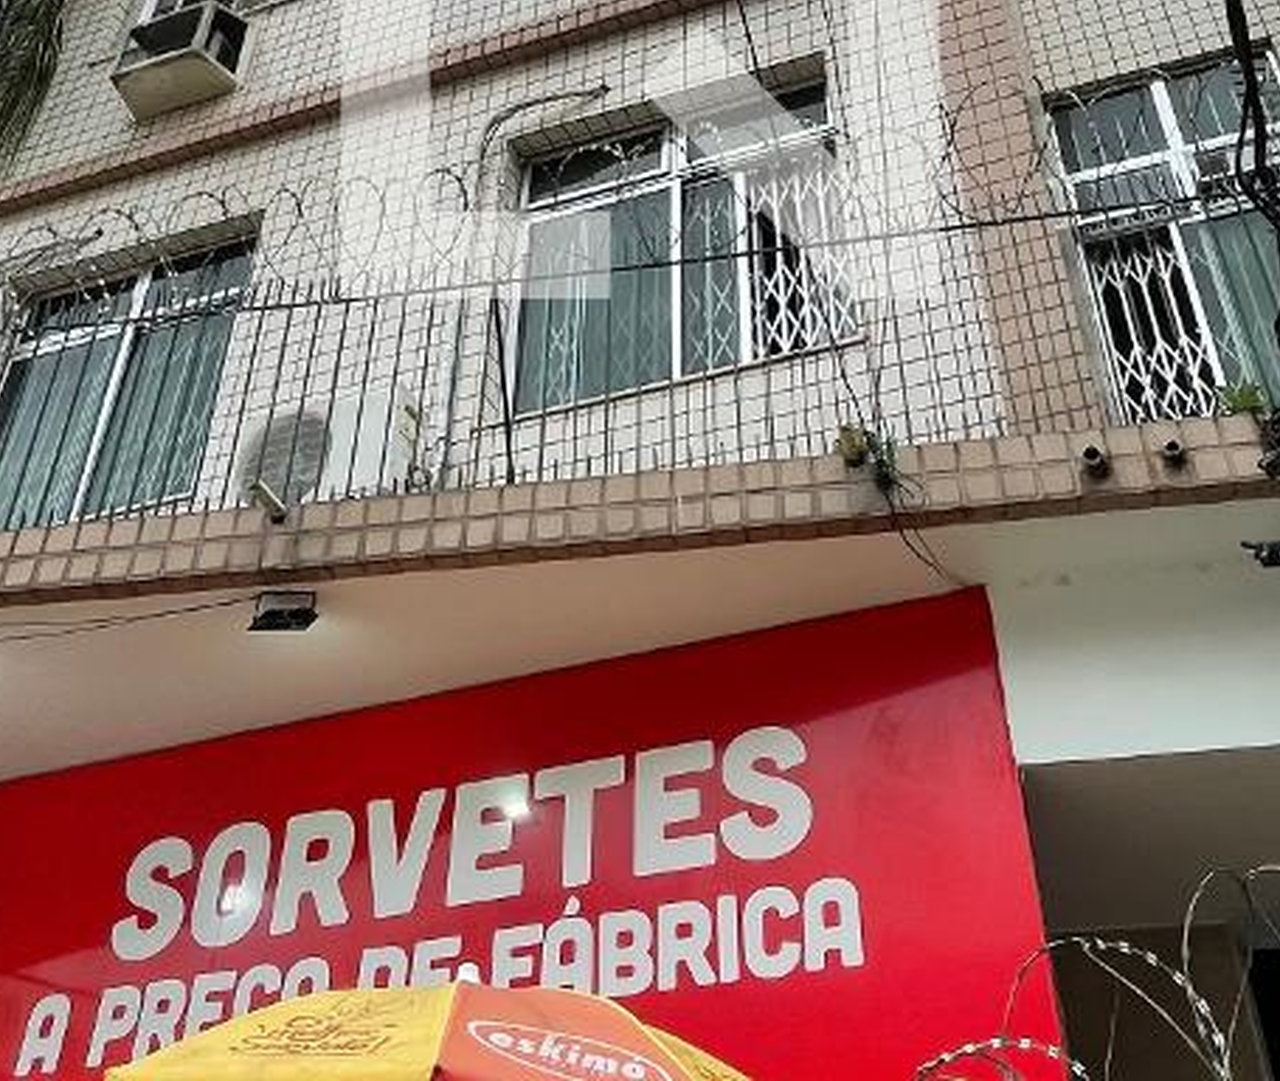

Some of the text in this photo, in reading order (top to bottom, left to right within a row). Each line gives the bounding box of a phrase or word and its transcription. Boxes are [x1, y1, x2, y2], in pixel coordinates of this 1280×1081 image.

[111, 726, 814, 962] SORVETES
[14, 993, 72, 1076] A
[491, 877, 865, 997] FÁBRICA
